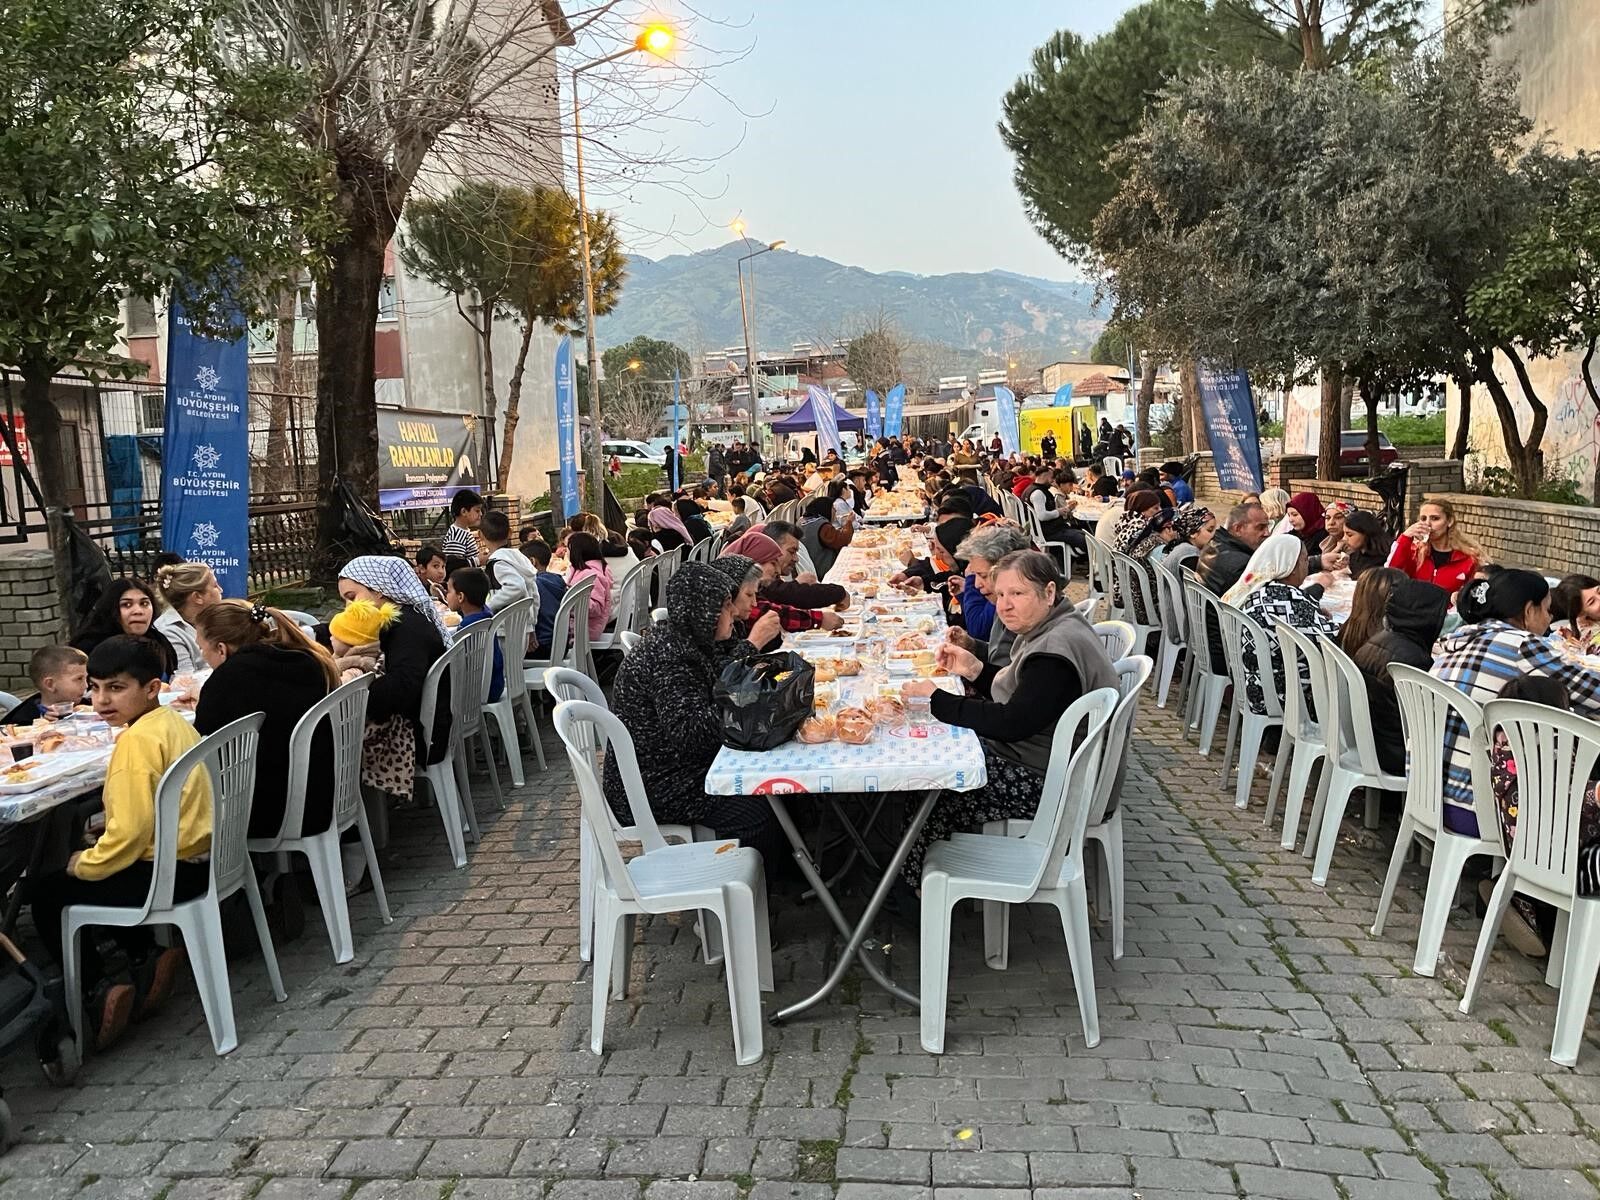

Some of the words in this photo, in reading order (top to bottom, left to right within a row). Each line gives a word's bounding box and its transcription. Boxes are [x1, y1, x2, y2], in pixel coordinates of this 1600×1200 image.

[204, 393, 226, 402] AYDIN
[177, 396, 240, 413] BÜYÜKŞEHİR
[186, 409, 230, 419] BELEDİYESİ
[398, 421, 438, 443] HAYIRLI
[388, 445, 454, 467] RAMAZANLAR
[202, 471, 226, 479] AYDIN
[173, 476, 240, 490] BÜYÜKŞEHİR
[184, 489, 229, 497] BELEDİYESİ
[185, 557, 239, 568] YÜKŞEHİR
